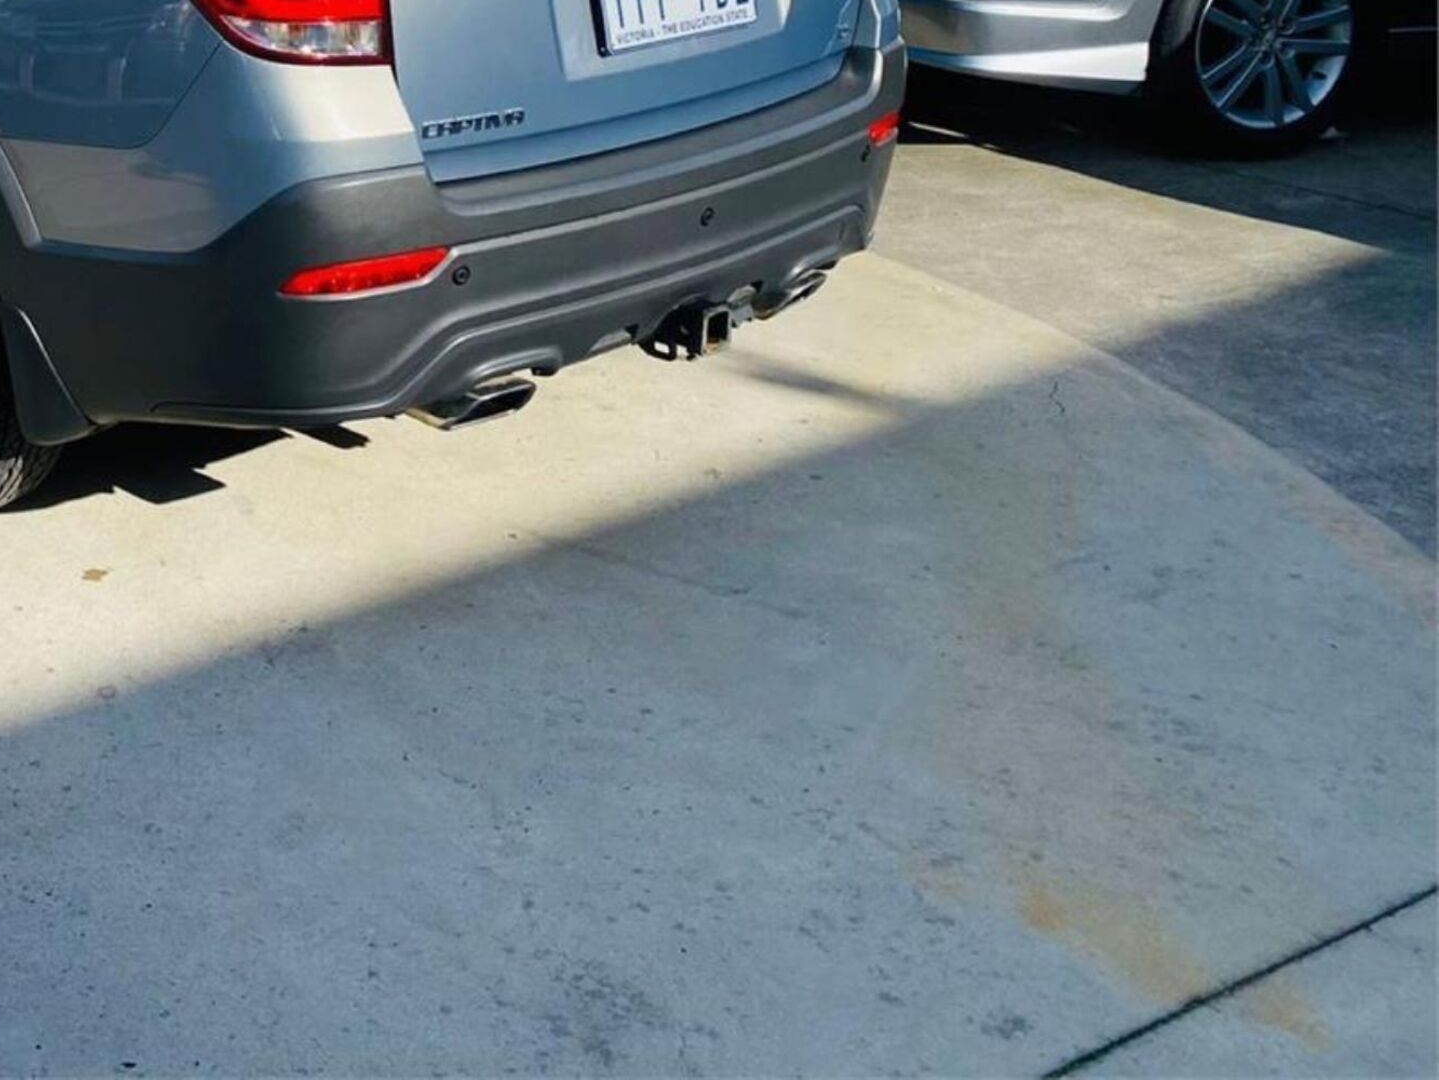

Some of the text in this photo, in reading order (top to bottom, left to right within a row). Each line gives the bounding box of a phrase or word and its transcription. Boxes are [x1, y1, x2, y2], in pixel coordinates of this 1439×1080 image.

[616, 28, 655, 44] VICTORIA
[662, 21, 678, 35] THE
[679, 14, 724, 33] EDUCATION
[725, 8, 749, 24] STATE
